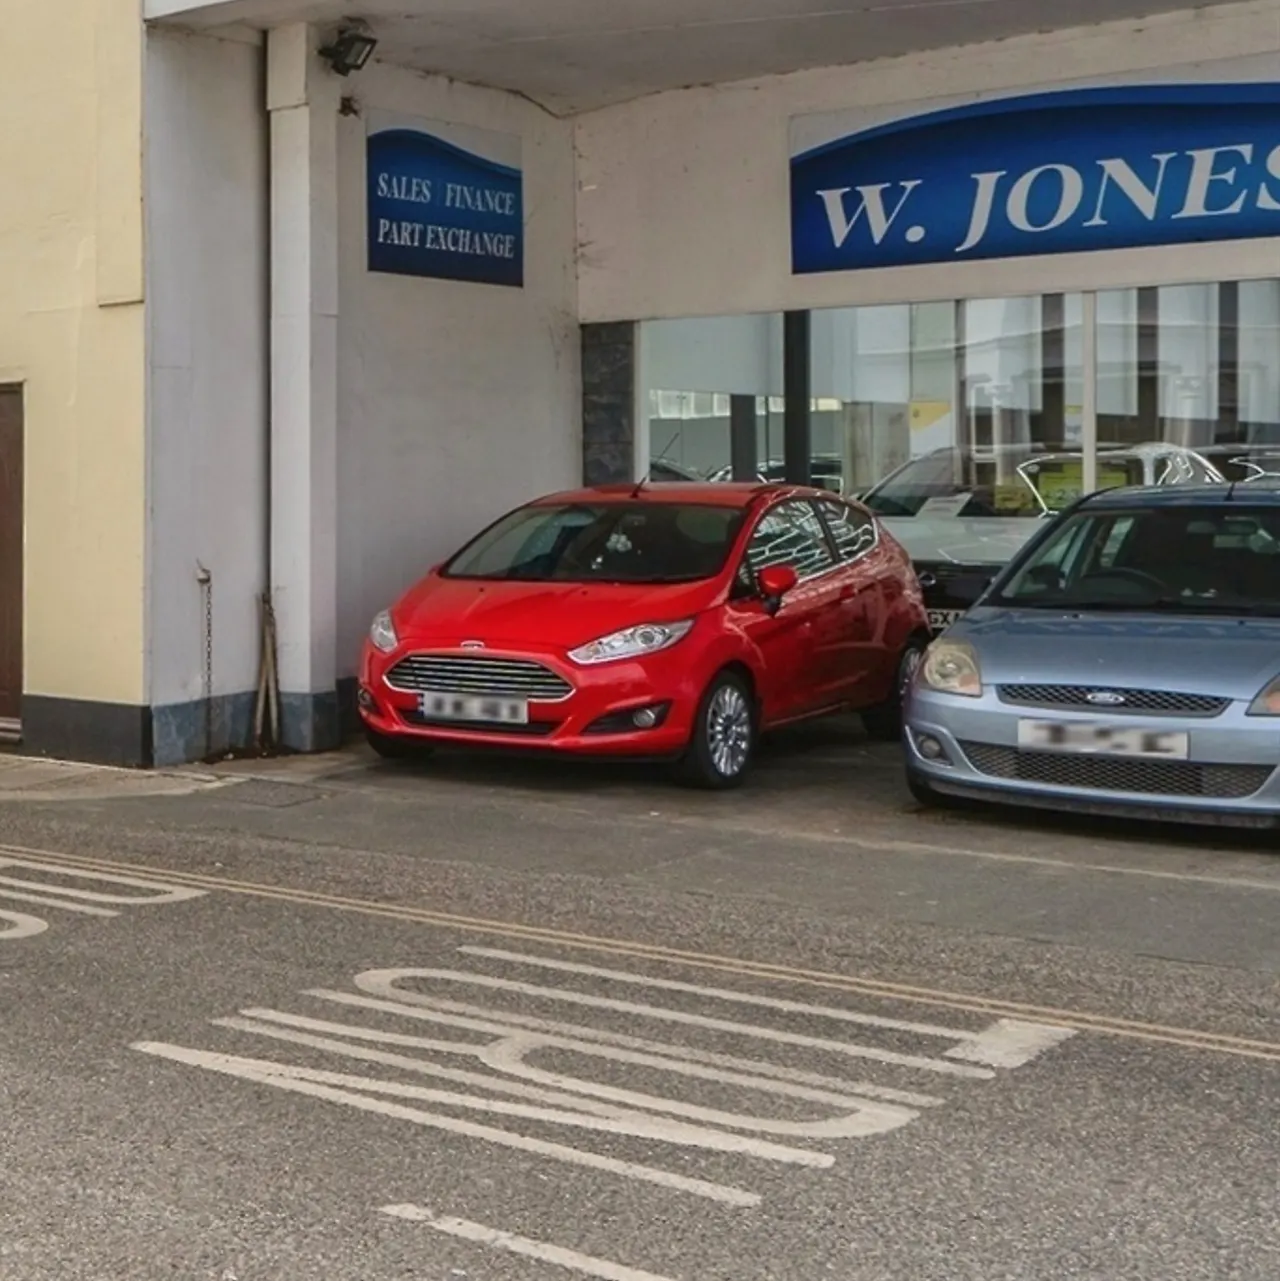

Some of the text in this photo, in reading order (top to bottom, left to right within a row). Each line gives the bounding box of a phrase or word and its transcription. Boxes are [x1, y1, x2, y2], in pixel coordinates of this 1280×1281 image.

[377, 172, 516, 216] SALES FINANCE
[815, 179, 925, 248] W.
[377, 218, 516, 259] PART EXCHANGE
[130, 945, 1078, 1207] TURN
